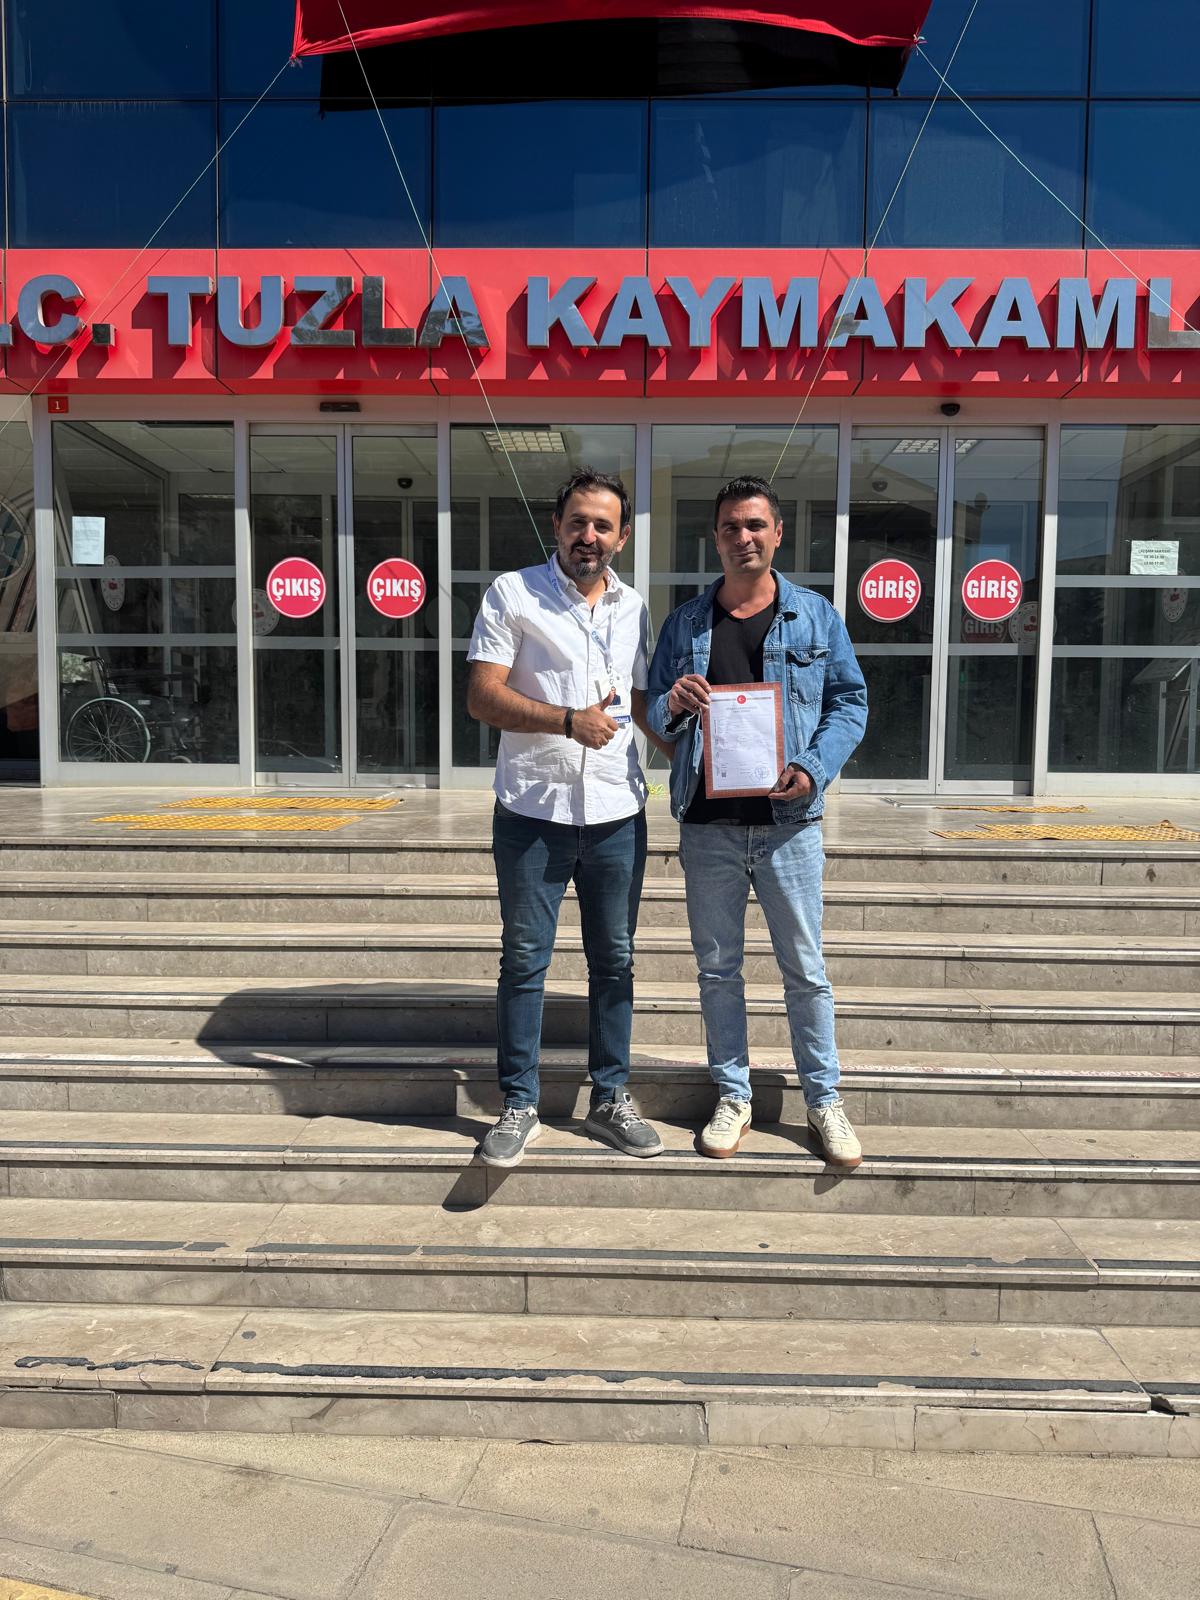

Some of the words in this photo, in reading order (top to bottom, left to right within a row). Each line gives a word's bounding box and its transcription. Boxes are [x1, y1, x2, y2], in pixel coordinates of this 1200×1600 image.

[147, 275, 492, 348] TUZLA
[54, 400, 61, 410] 1
[271, 577, 321, 602] ÇIKIŞ
[372, 577, 421, 603] ÇIKIŞ
[864, 575, 917, 604] GİRİŞ
[966, 575, 1019, 604] GİRİŞ
